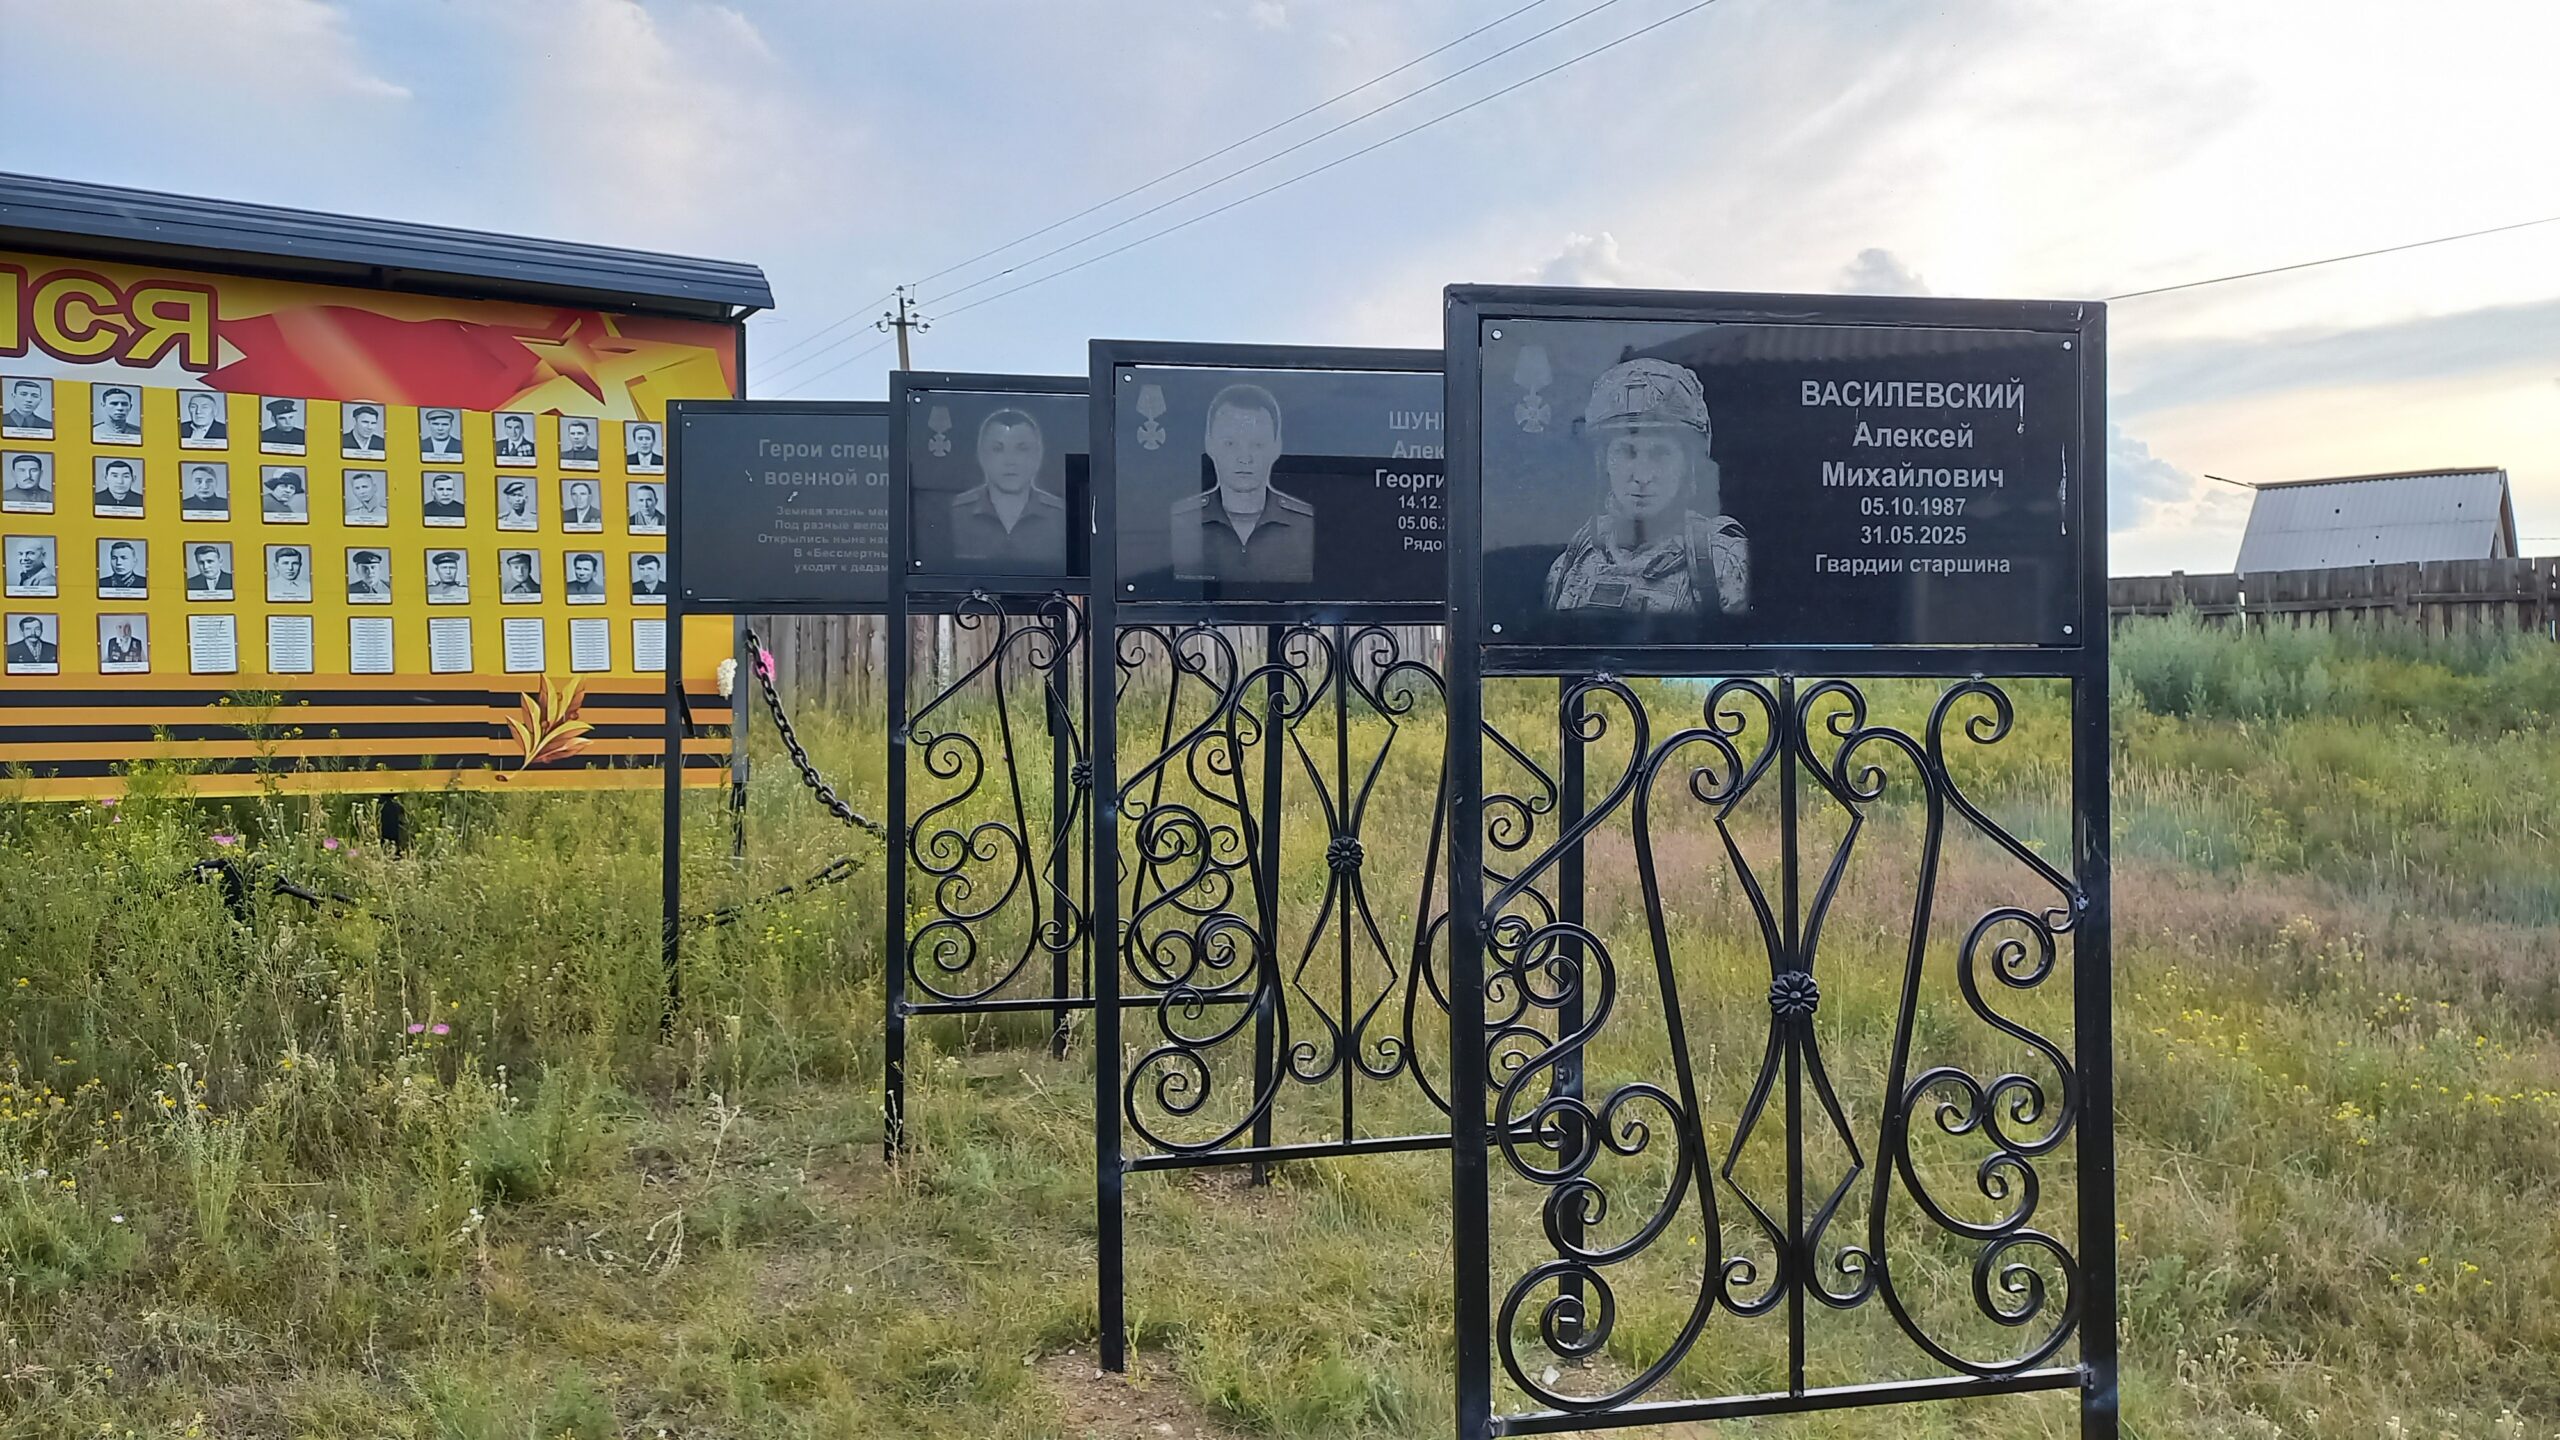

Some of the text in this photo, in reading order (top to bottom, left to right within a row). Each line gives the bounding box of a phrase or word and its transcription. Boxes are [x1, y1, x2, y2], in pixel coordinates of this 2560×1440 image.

[0, 268, 215, 371] СЯ
[1801, 377, 2025, 409] ВАСИЛЕВСКИЙ
[1389, 410, 1445, 431] ШУН
[1852, 421, 1974, 448] Алексей
[758, 439, 823, 462] Герои
[764, 468, 858, 486] военной
[1821, 461, 2004, 488] Михайлович
[776, 506, 822, 516] Земная
[1398, 495, 1445, 509] 14.12.
[1860, 497, 1966, 516] 05.10.1987
[774, 519, 799, 531] Под
[803, 521, 850, 531] разные
[757, 533, 830, 544] Открылись
[1404, 537, 1445, 553] Рядо
[1860, 526, 1967, 545] 31.05.2025
[793, 548, 803, 558] В
[794, 563, 837, 574] уходят
[1815, 554, 2011, 576] Гвардии старшина
